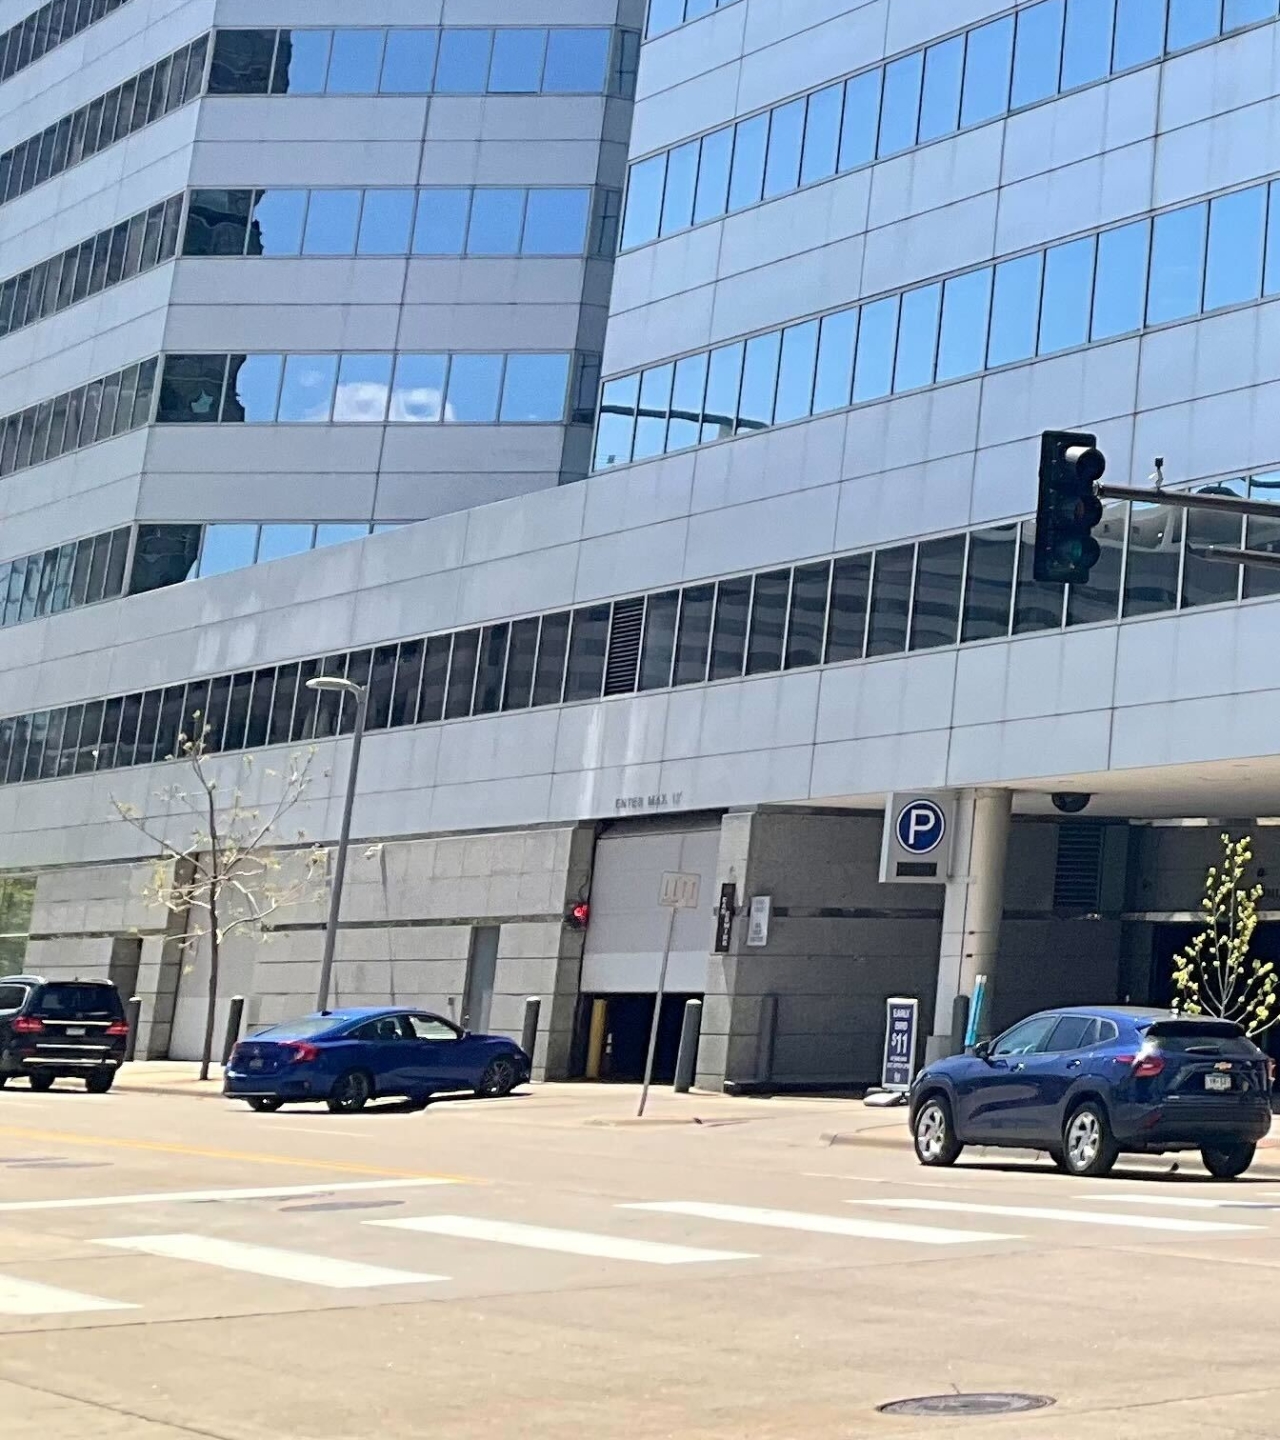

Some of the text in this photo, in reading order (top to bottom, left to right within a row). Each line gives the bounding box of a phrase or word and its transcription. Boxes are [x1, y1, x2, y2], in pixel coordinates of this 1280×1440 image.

[616, 797, 643, 808] ENTER
[648, 794, 668, 806] MAX
[908, 809, 935, 845] P
[892, 1007, 911, 1019] EARLY
[891, 1032, 908, 1054] $11
